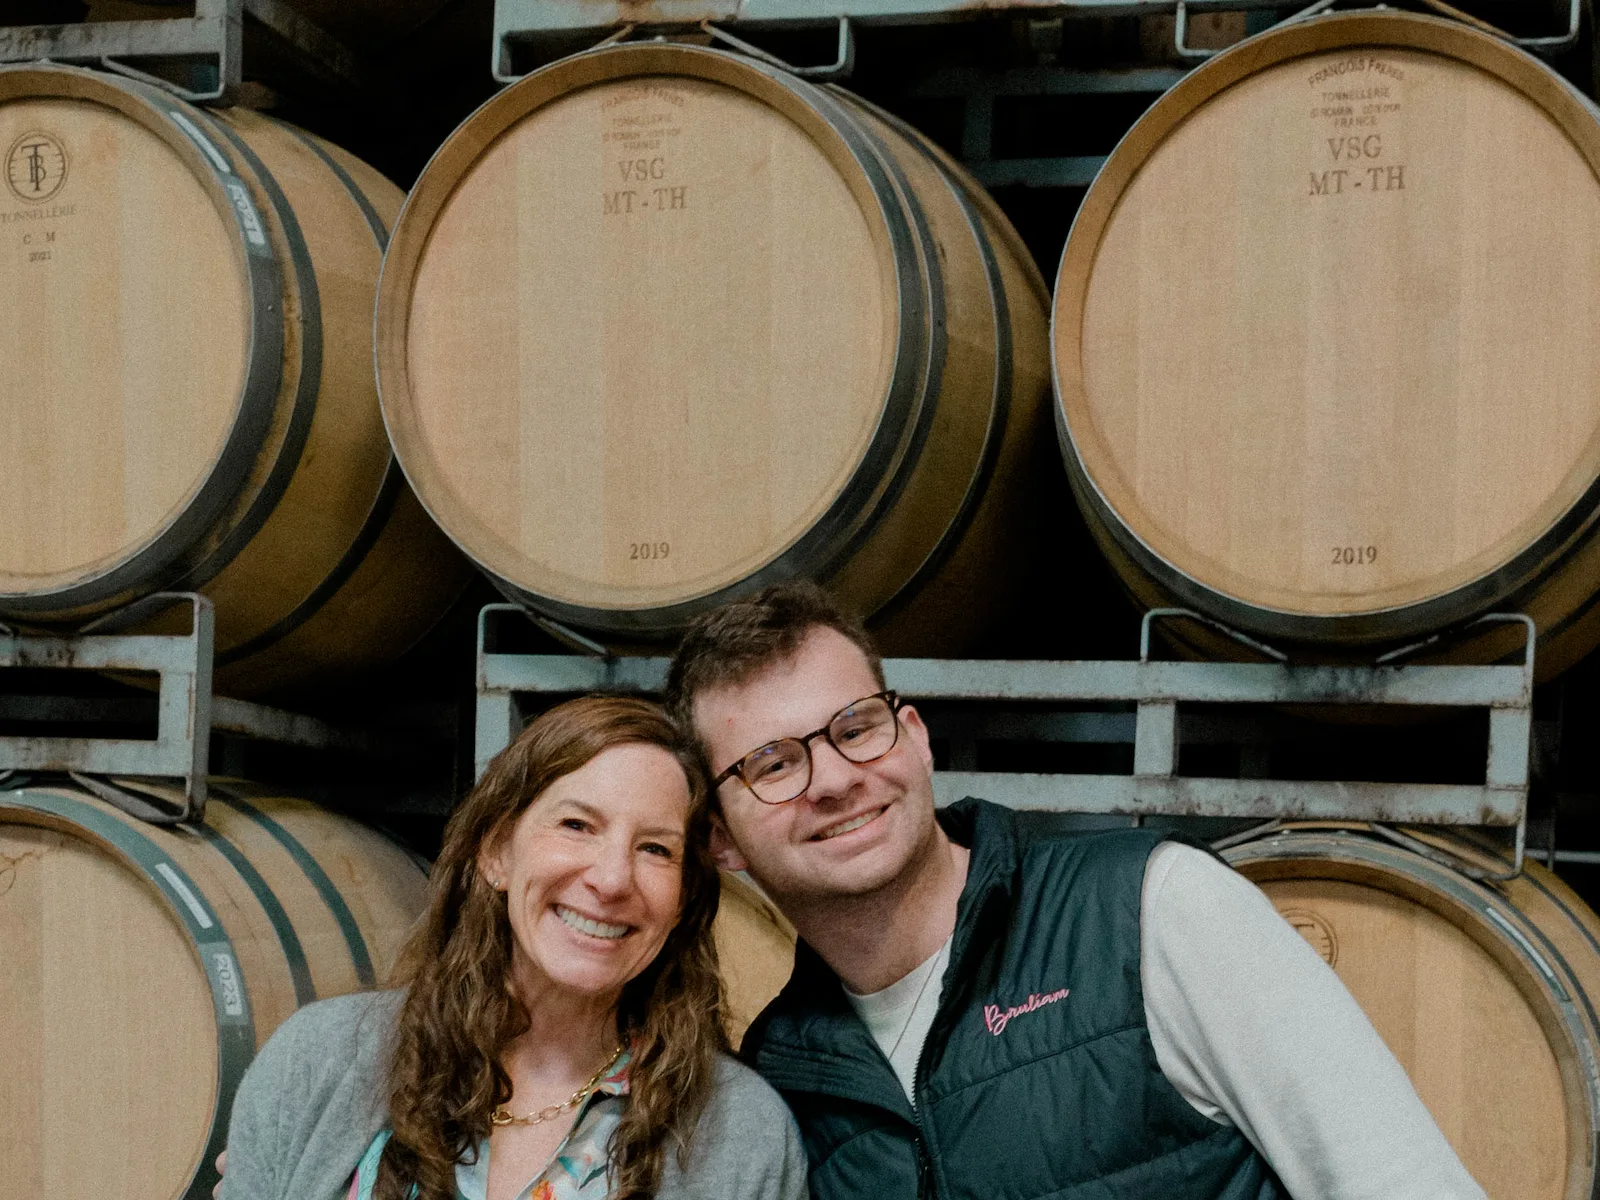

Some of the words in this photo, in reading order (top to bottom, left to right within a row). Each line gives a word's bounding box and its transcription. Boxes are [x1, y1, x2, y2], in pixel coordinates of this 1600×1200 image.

[1327, 134, 1382, 160] VSG
[618, 158, 665, 181] VSG
[629, 541, 670, 560] 2019
[1331, 545, 1378, 565] 2019
[983, 988, 1070, 1037] Bruliam
